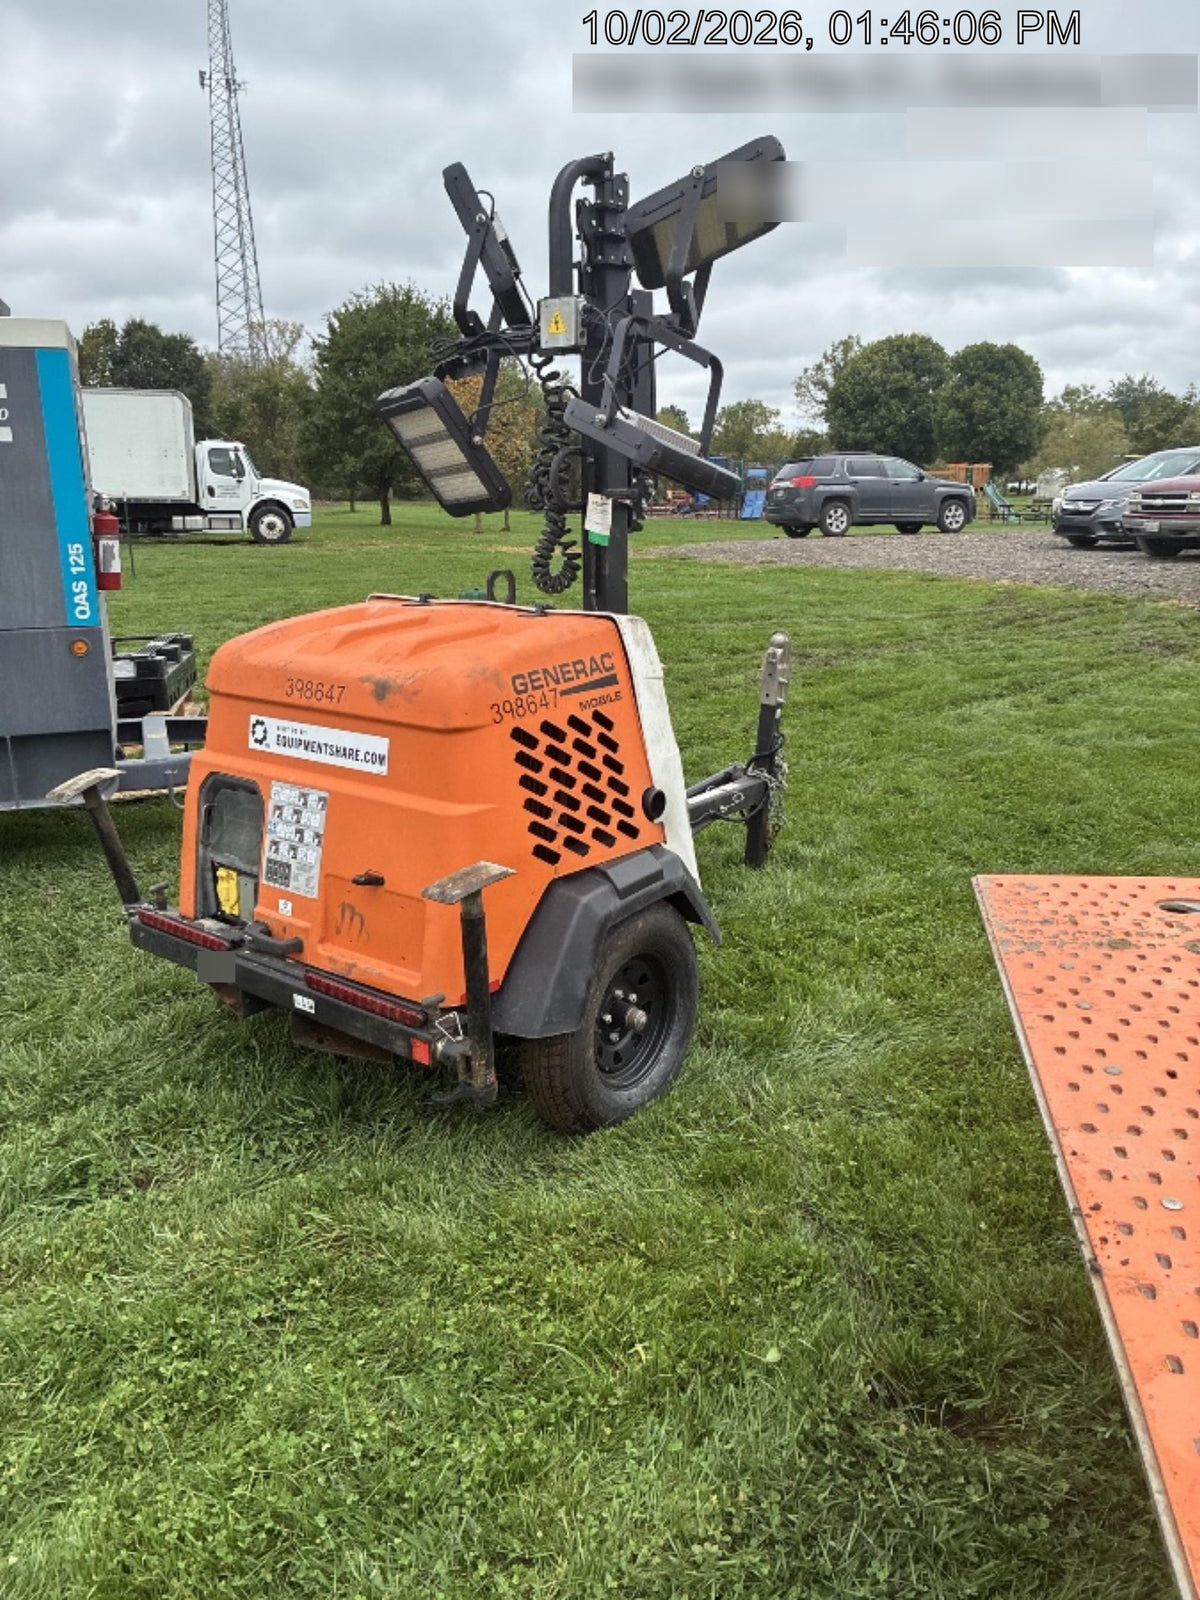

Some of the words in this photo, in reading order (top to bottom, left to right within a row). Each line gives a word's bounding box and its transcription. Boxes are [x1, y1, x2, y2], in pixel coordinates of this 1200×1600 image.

[67, 543, 86, 575] 125
[72, 581, 91, 620] QAS
[511, 652, 616, 695] GENERAC
[285, 678, 346, 704] 398647
[489, 687, 558, 724] 398647
[579, 691, 623, 712] MOBILE
[276, 733, 386, 766] EQUIPMENTSHARE.COM
